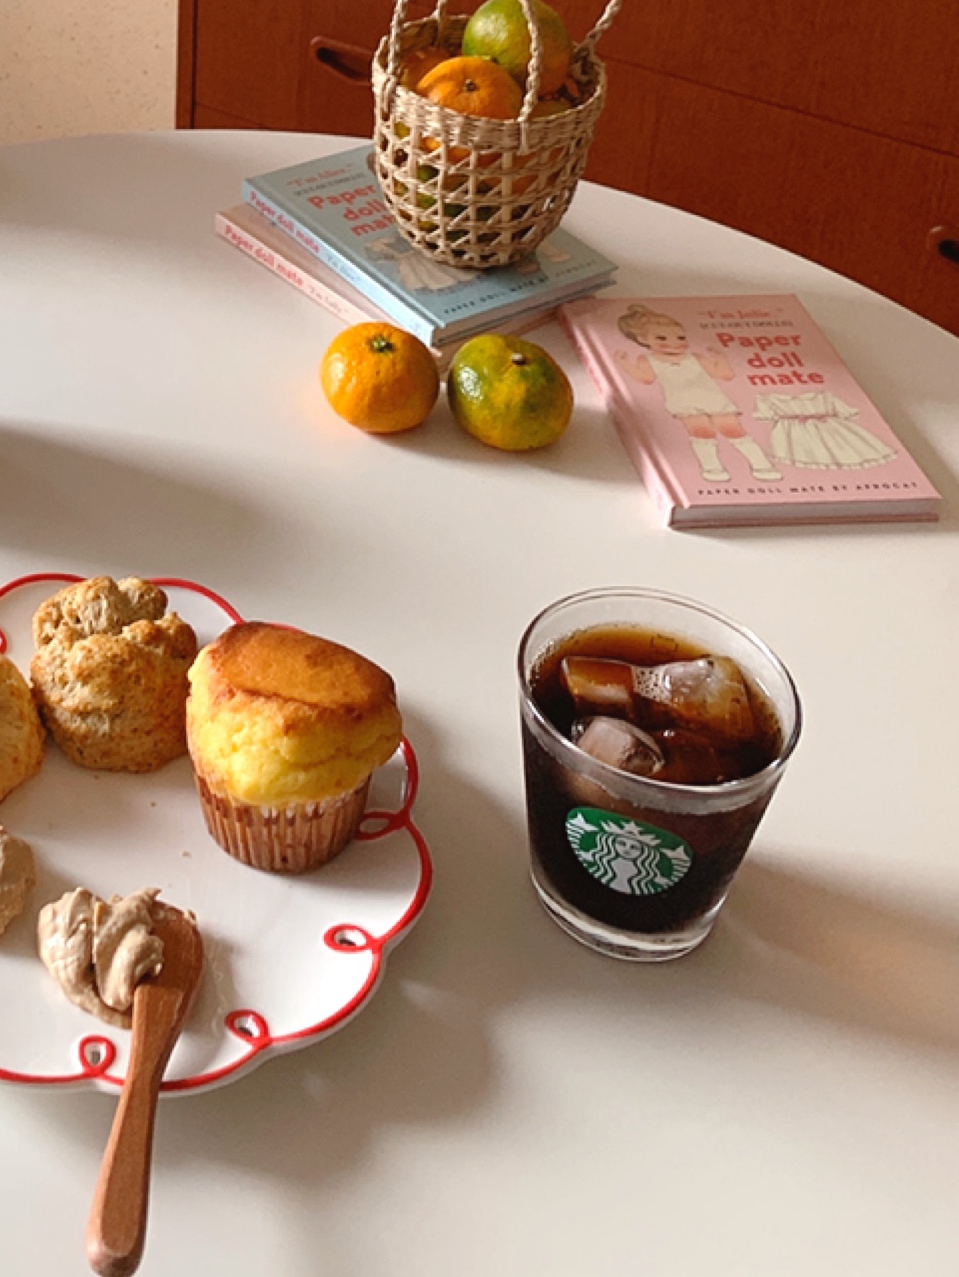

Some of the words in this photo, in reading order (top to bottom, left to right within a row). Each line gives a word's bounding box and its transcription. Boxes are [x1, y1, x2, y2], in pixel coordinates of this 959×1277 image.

[308, 184, 377, 210] Paper
[249, 190, 276, 217] Paper
[275, 214, 295, 233] doll
[343, 198, 388, 221] doll
[351, 214, 396, 237] mat
[225, 224, 254, 252] Paper
[254, 248, 276, 268] doll
[276, 263, 304, 287] mate
[715, 331, 801, 352] Paper
[746, 351, 804, 370] doll
[746, 369, 825, 386] mate
[698, 488, 740, 496] PAPER
[747, 487, 783, 495] DOLL
[789, 485, 825, 494] MATE
